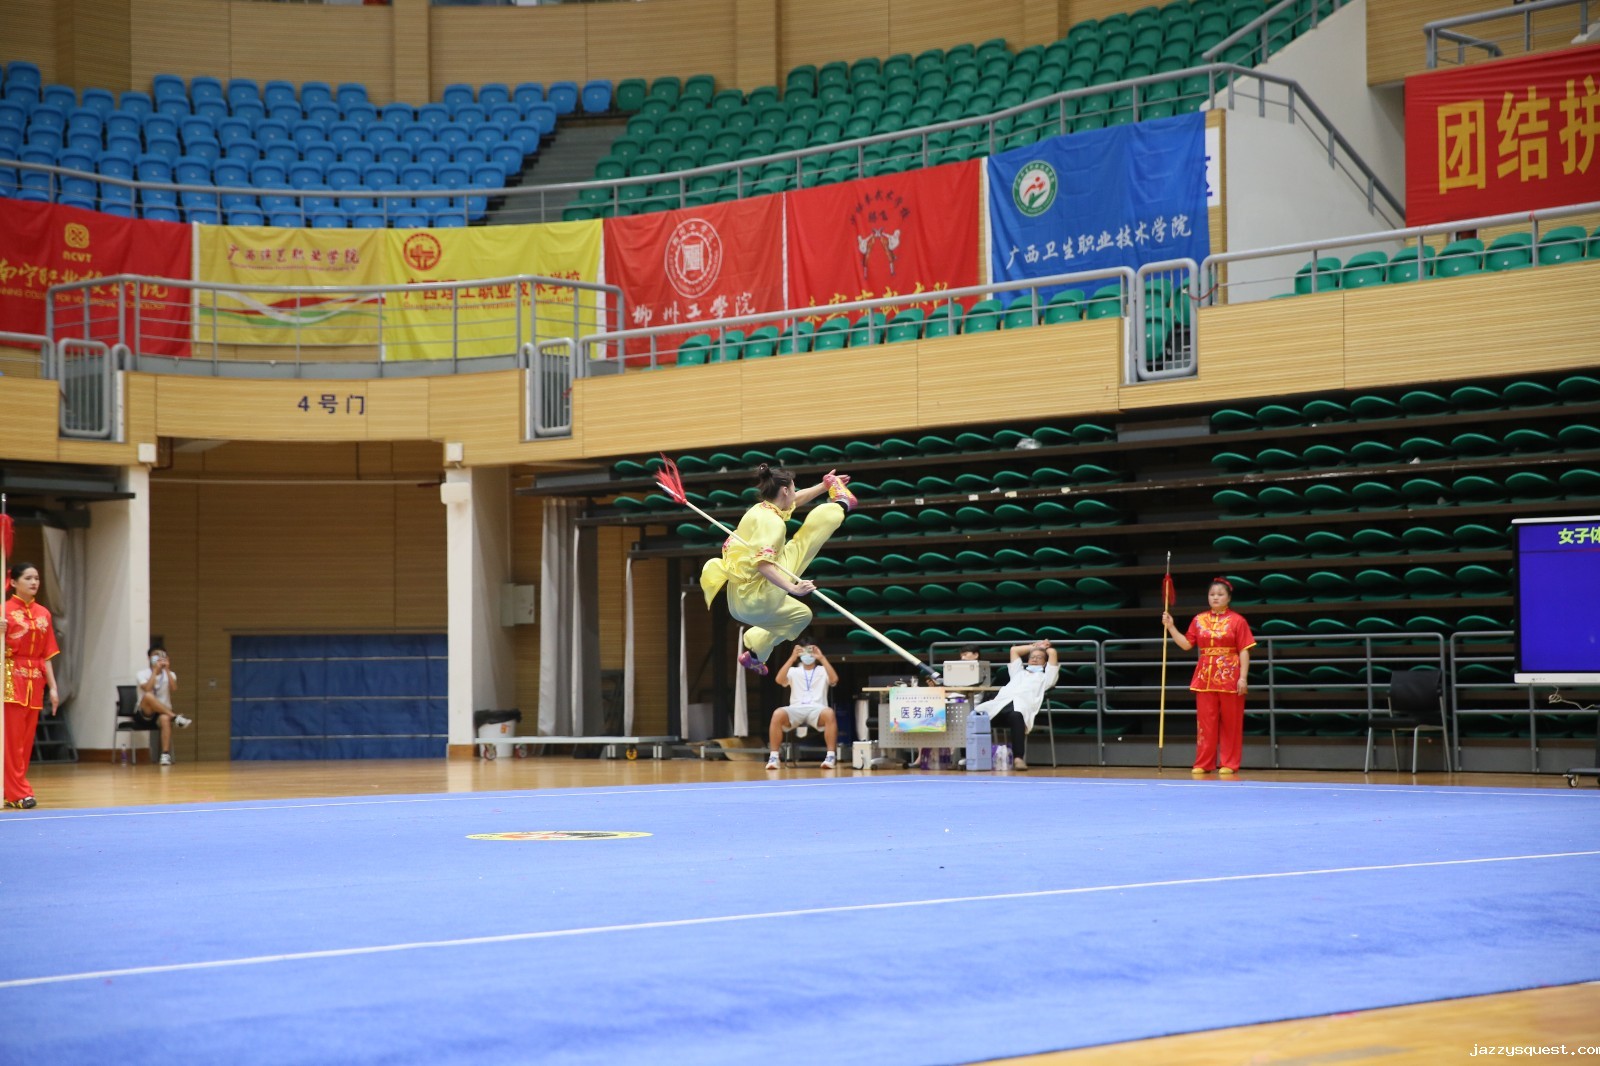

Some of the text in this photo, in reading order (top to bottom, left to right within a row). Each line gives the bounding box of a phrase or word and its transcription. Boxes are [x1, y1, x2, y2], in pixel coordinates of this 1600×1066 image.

[1437, 75, 1600, 195] 团结拼
[1005, 214, 1192, 270] 广西卫生职业技术学院
[297, 394, 364, 415] 4号门
[901, 706, 934, 719] 医务席
